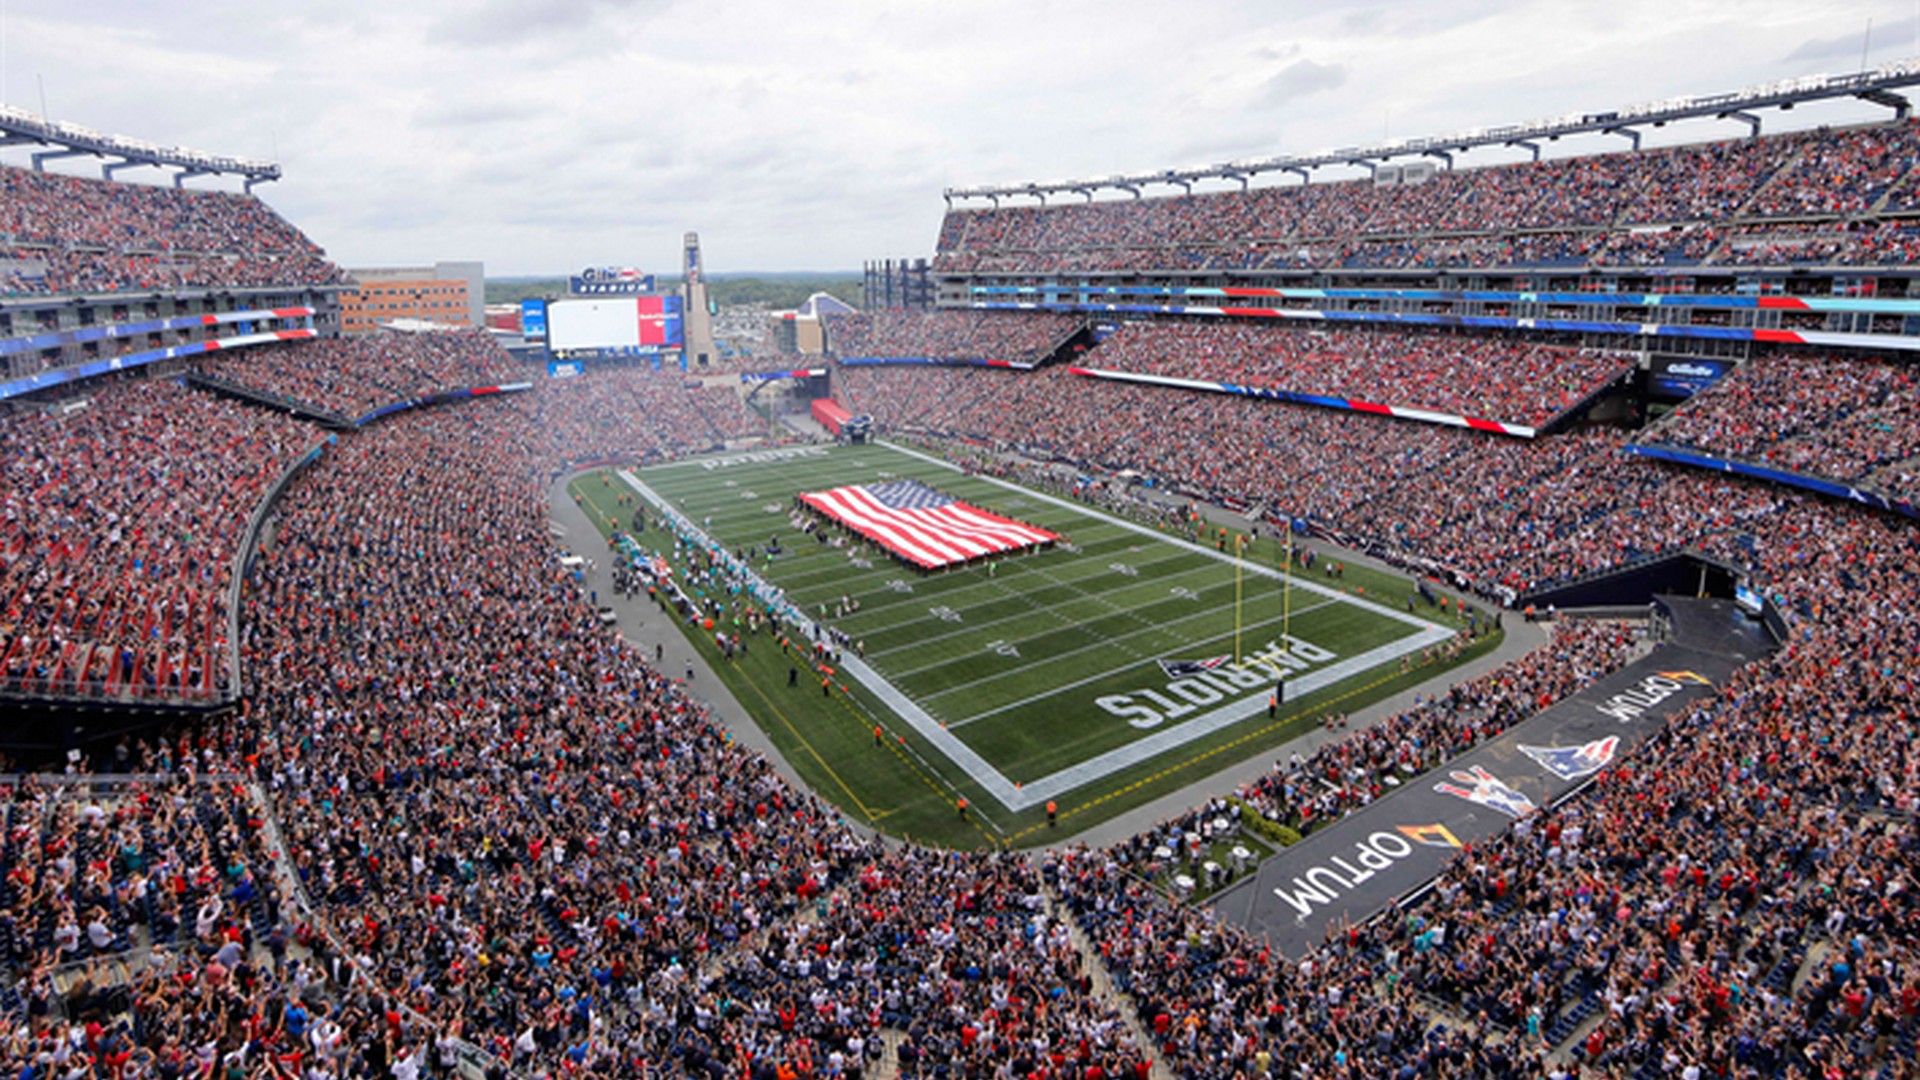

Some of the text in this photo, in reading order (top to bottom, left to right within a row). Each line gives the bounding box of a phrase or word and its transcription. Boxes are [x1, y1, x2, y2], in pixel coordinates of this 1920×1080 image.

[1095, 633, 1337, 729] PATRIOTS
[1595, 675, 1682, 722] OPTUM
[1273, 832, 1413, 916] OPTUM
